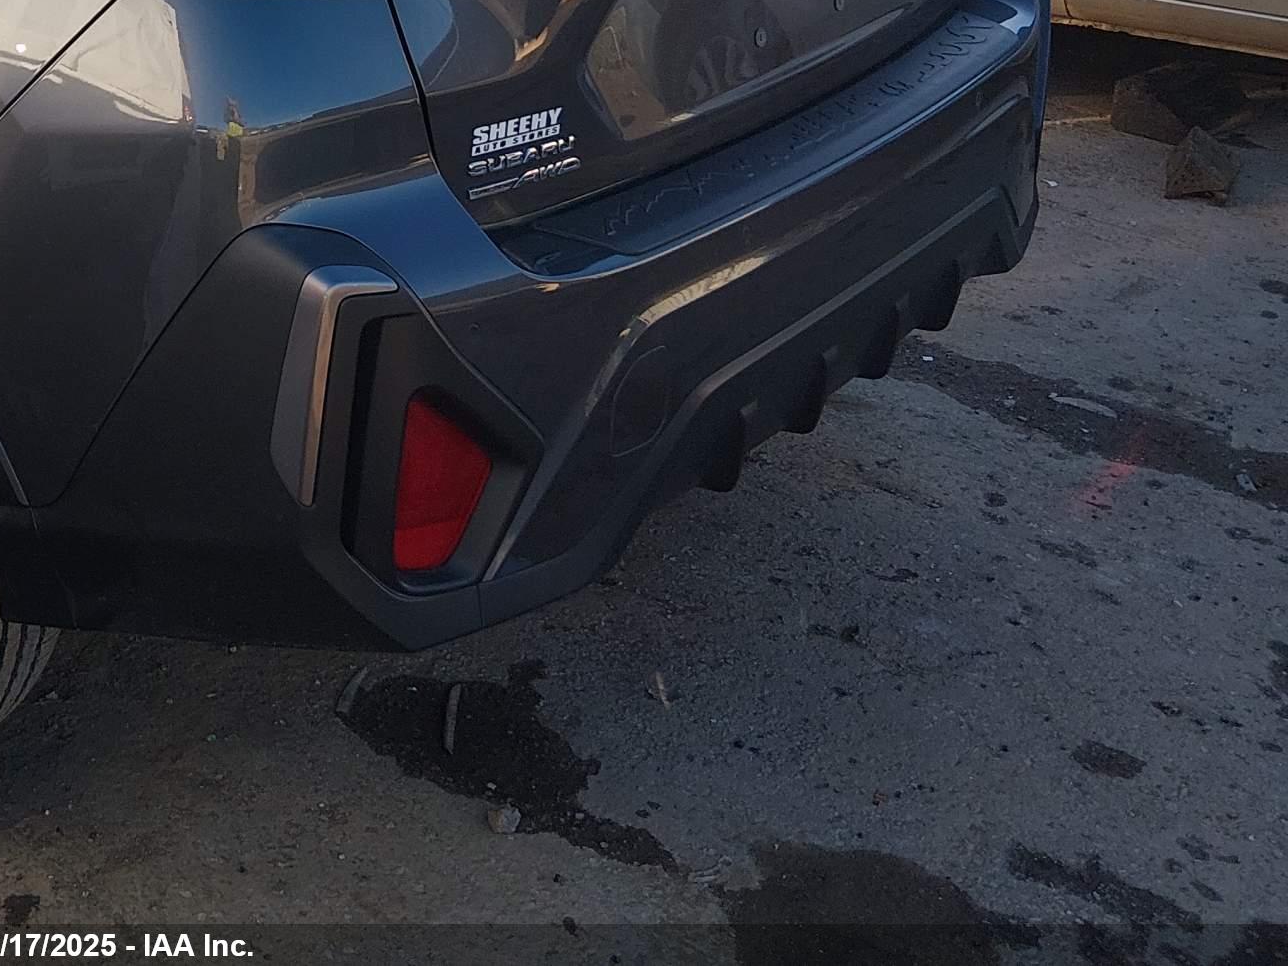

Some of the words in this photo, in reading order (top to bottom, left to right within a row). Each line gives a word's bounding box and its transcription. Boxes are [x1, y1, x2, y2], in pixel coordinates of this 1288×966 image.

[473, 107, 562, 145] SHEEHY
[468, 135, 575, 176] SUBARU
[474, 140, 507, 154] AUTO
[513, 157, 581, 189] AWD
